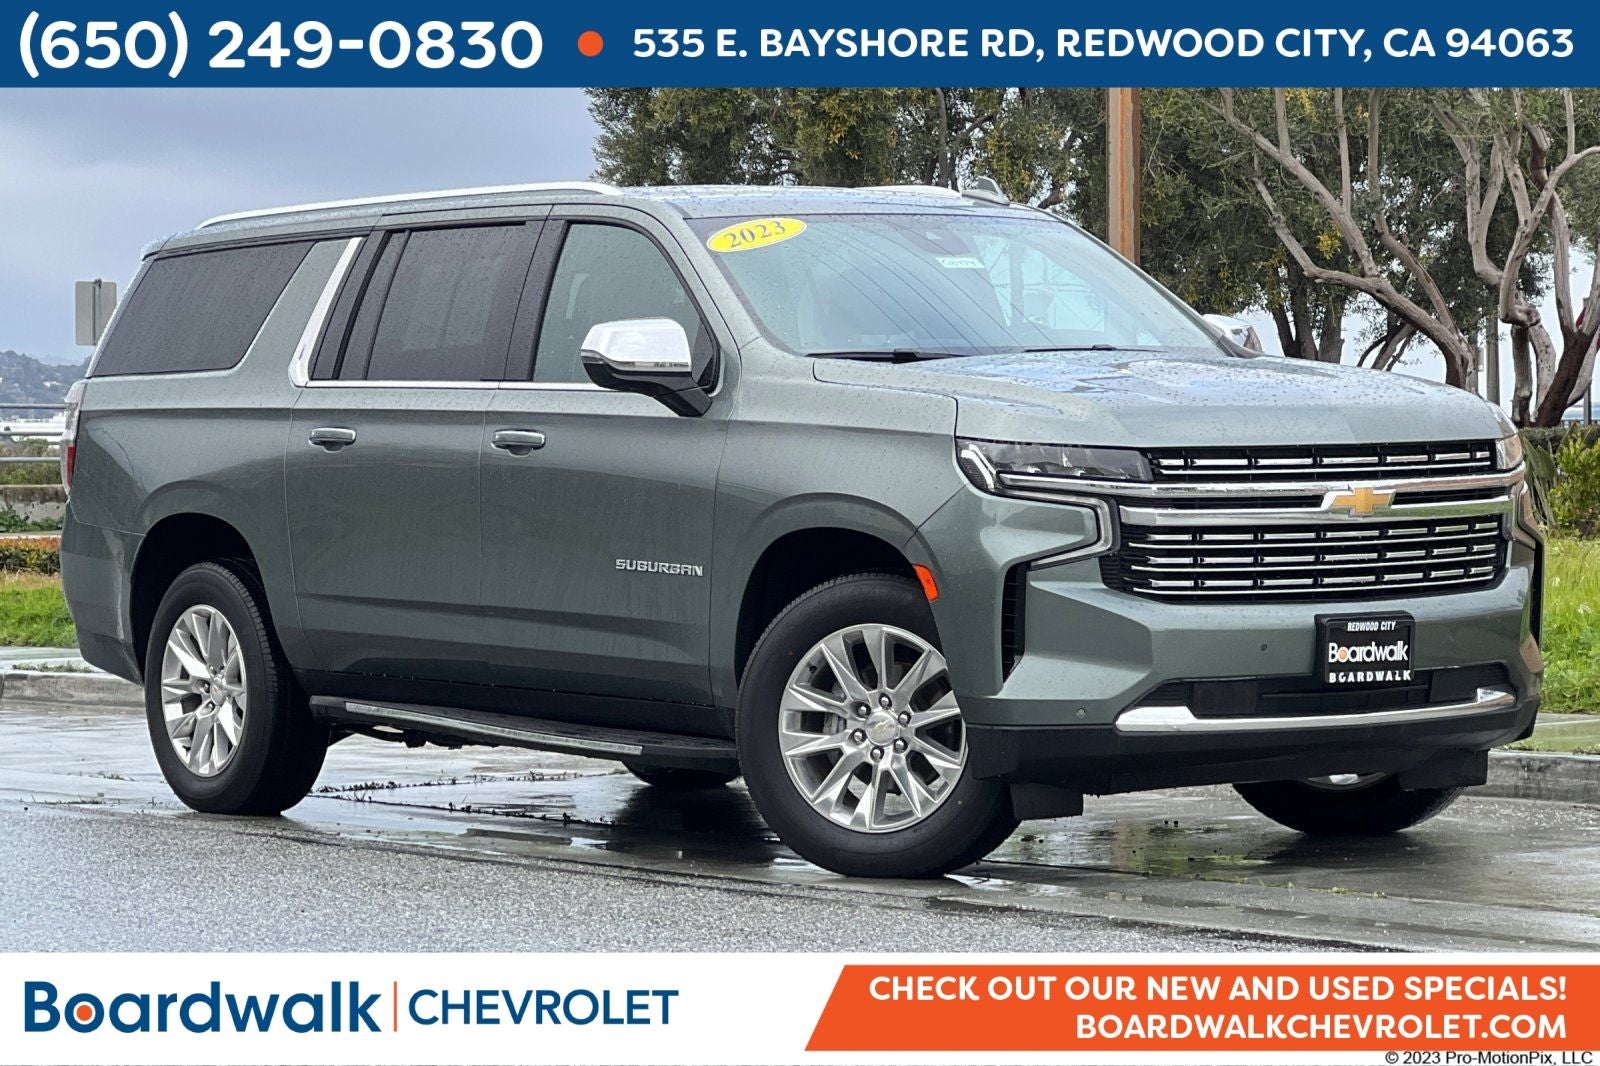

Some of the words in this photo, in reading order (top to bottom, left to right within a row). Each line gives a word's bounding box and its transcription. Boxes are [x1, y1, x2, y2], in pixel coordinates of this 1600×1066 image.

[723, 220, 786, 249] 2023
[615, 558, 704, 577] SUBURBAN
[1347, 621, 1379, 632] REDWOOD
[1380, 621, 1397, 631] CITY
[1328, 640, 1409, 663] Boardwalk
[1329, 670, 1412, 684] BOARDWALK
